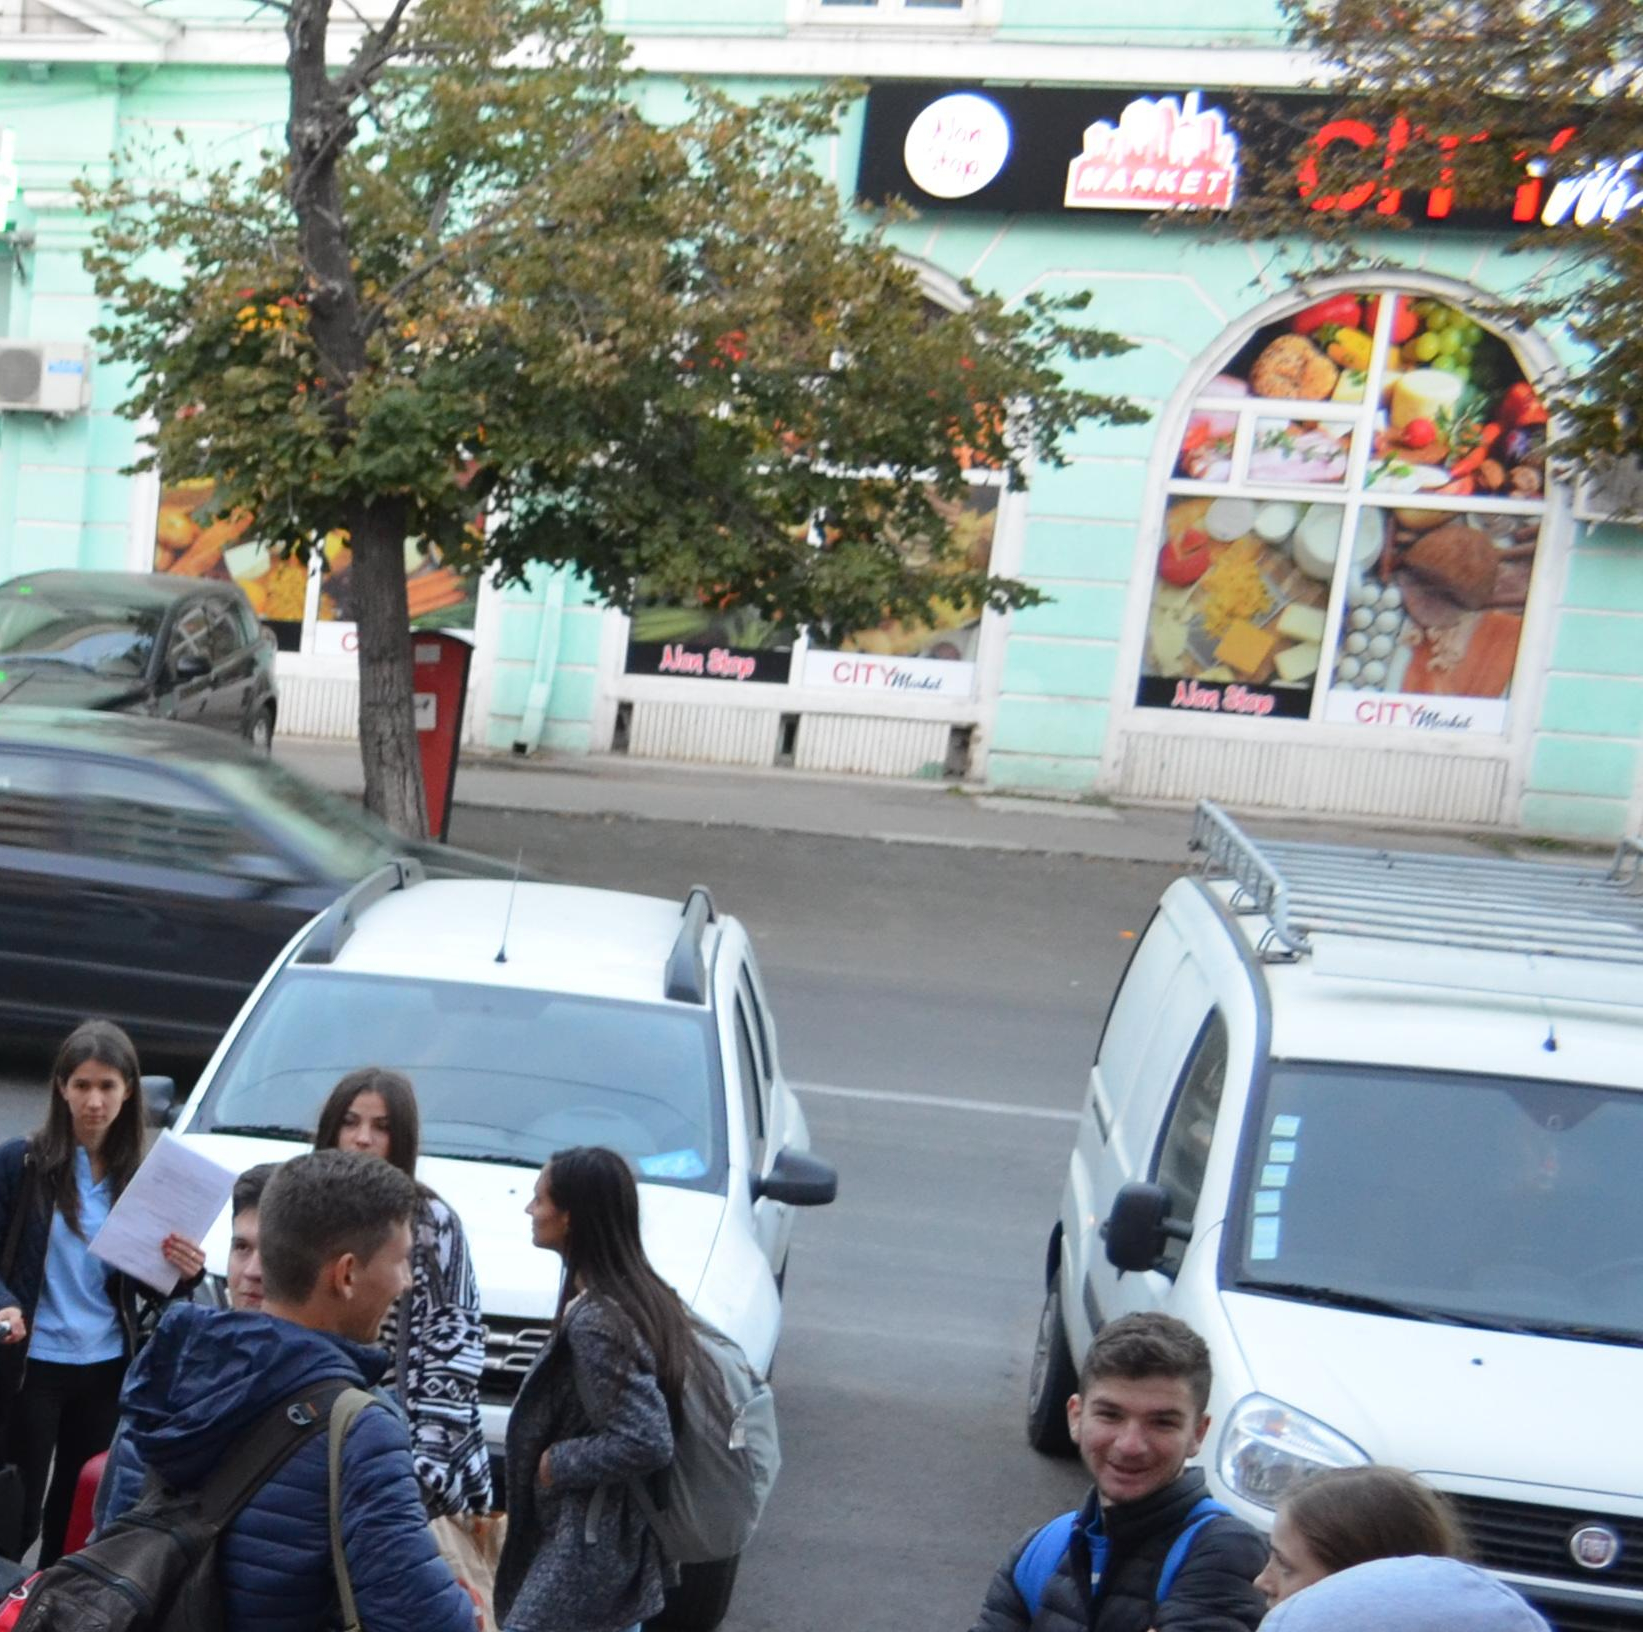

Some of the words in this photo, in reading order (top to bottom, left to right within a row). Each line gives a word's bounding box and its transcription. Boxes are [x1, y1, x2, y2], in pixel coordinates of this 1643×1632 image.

[1076, 166, 1227, 196] MARKET
[833, 661, 897, 686] CITY
[1355, 700, 1424, 725] CITY
